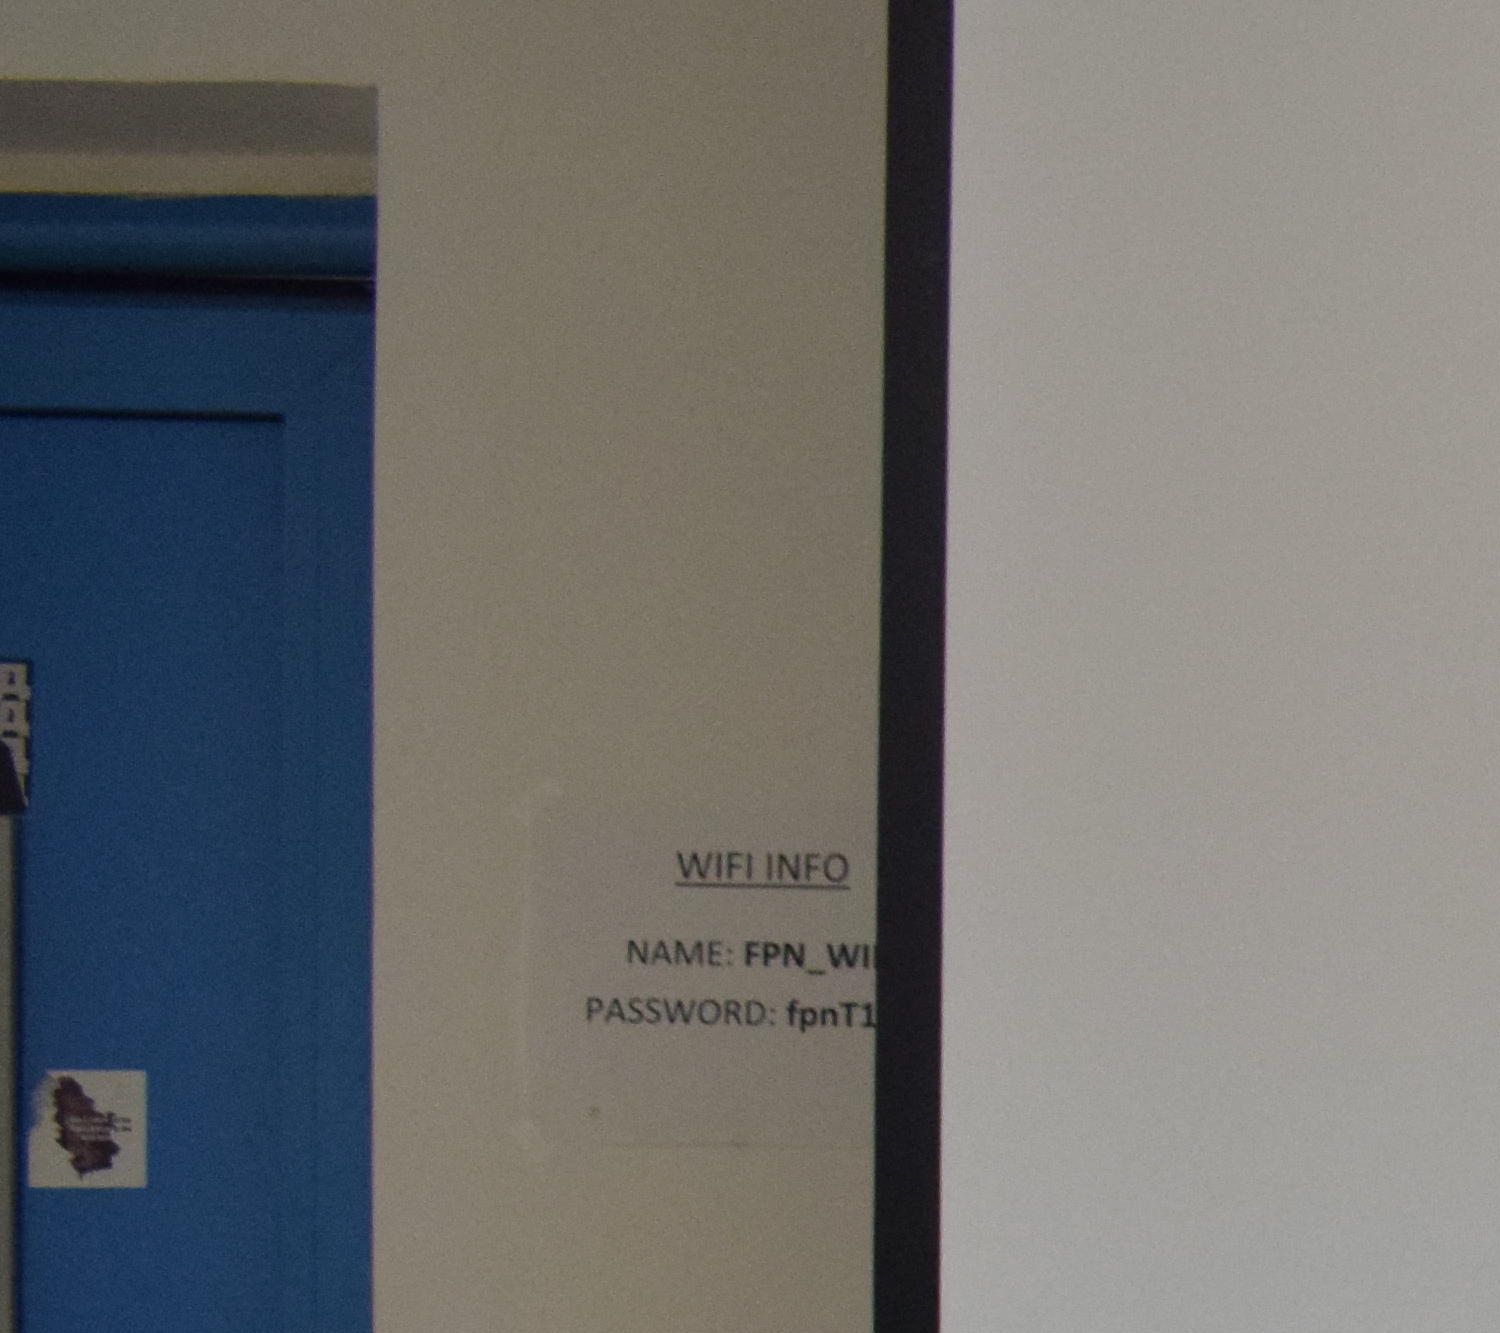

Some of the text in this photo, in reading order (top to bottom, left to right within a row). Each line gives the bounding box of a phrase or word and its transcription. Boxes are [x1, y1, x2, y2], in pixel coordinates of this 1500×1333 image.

[677, 851, 850, 883] WIFI INFO
[627, 940, 878, 976] NAME: FPN_WI
[586, 997, 777, 1026] PASSWORD:
